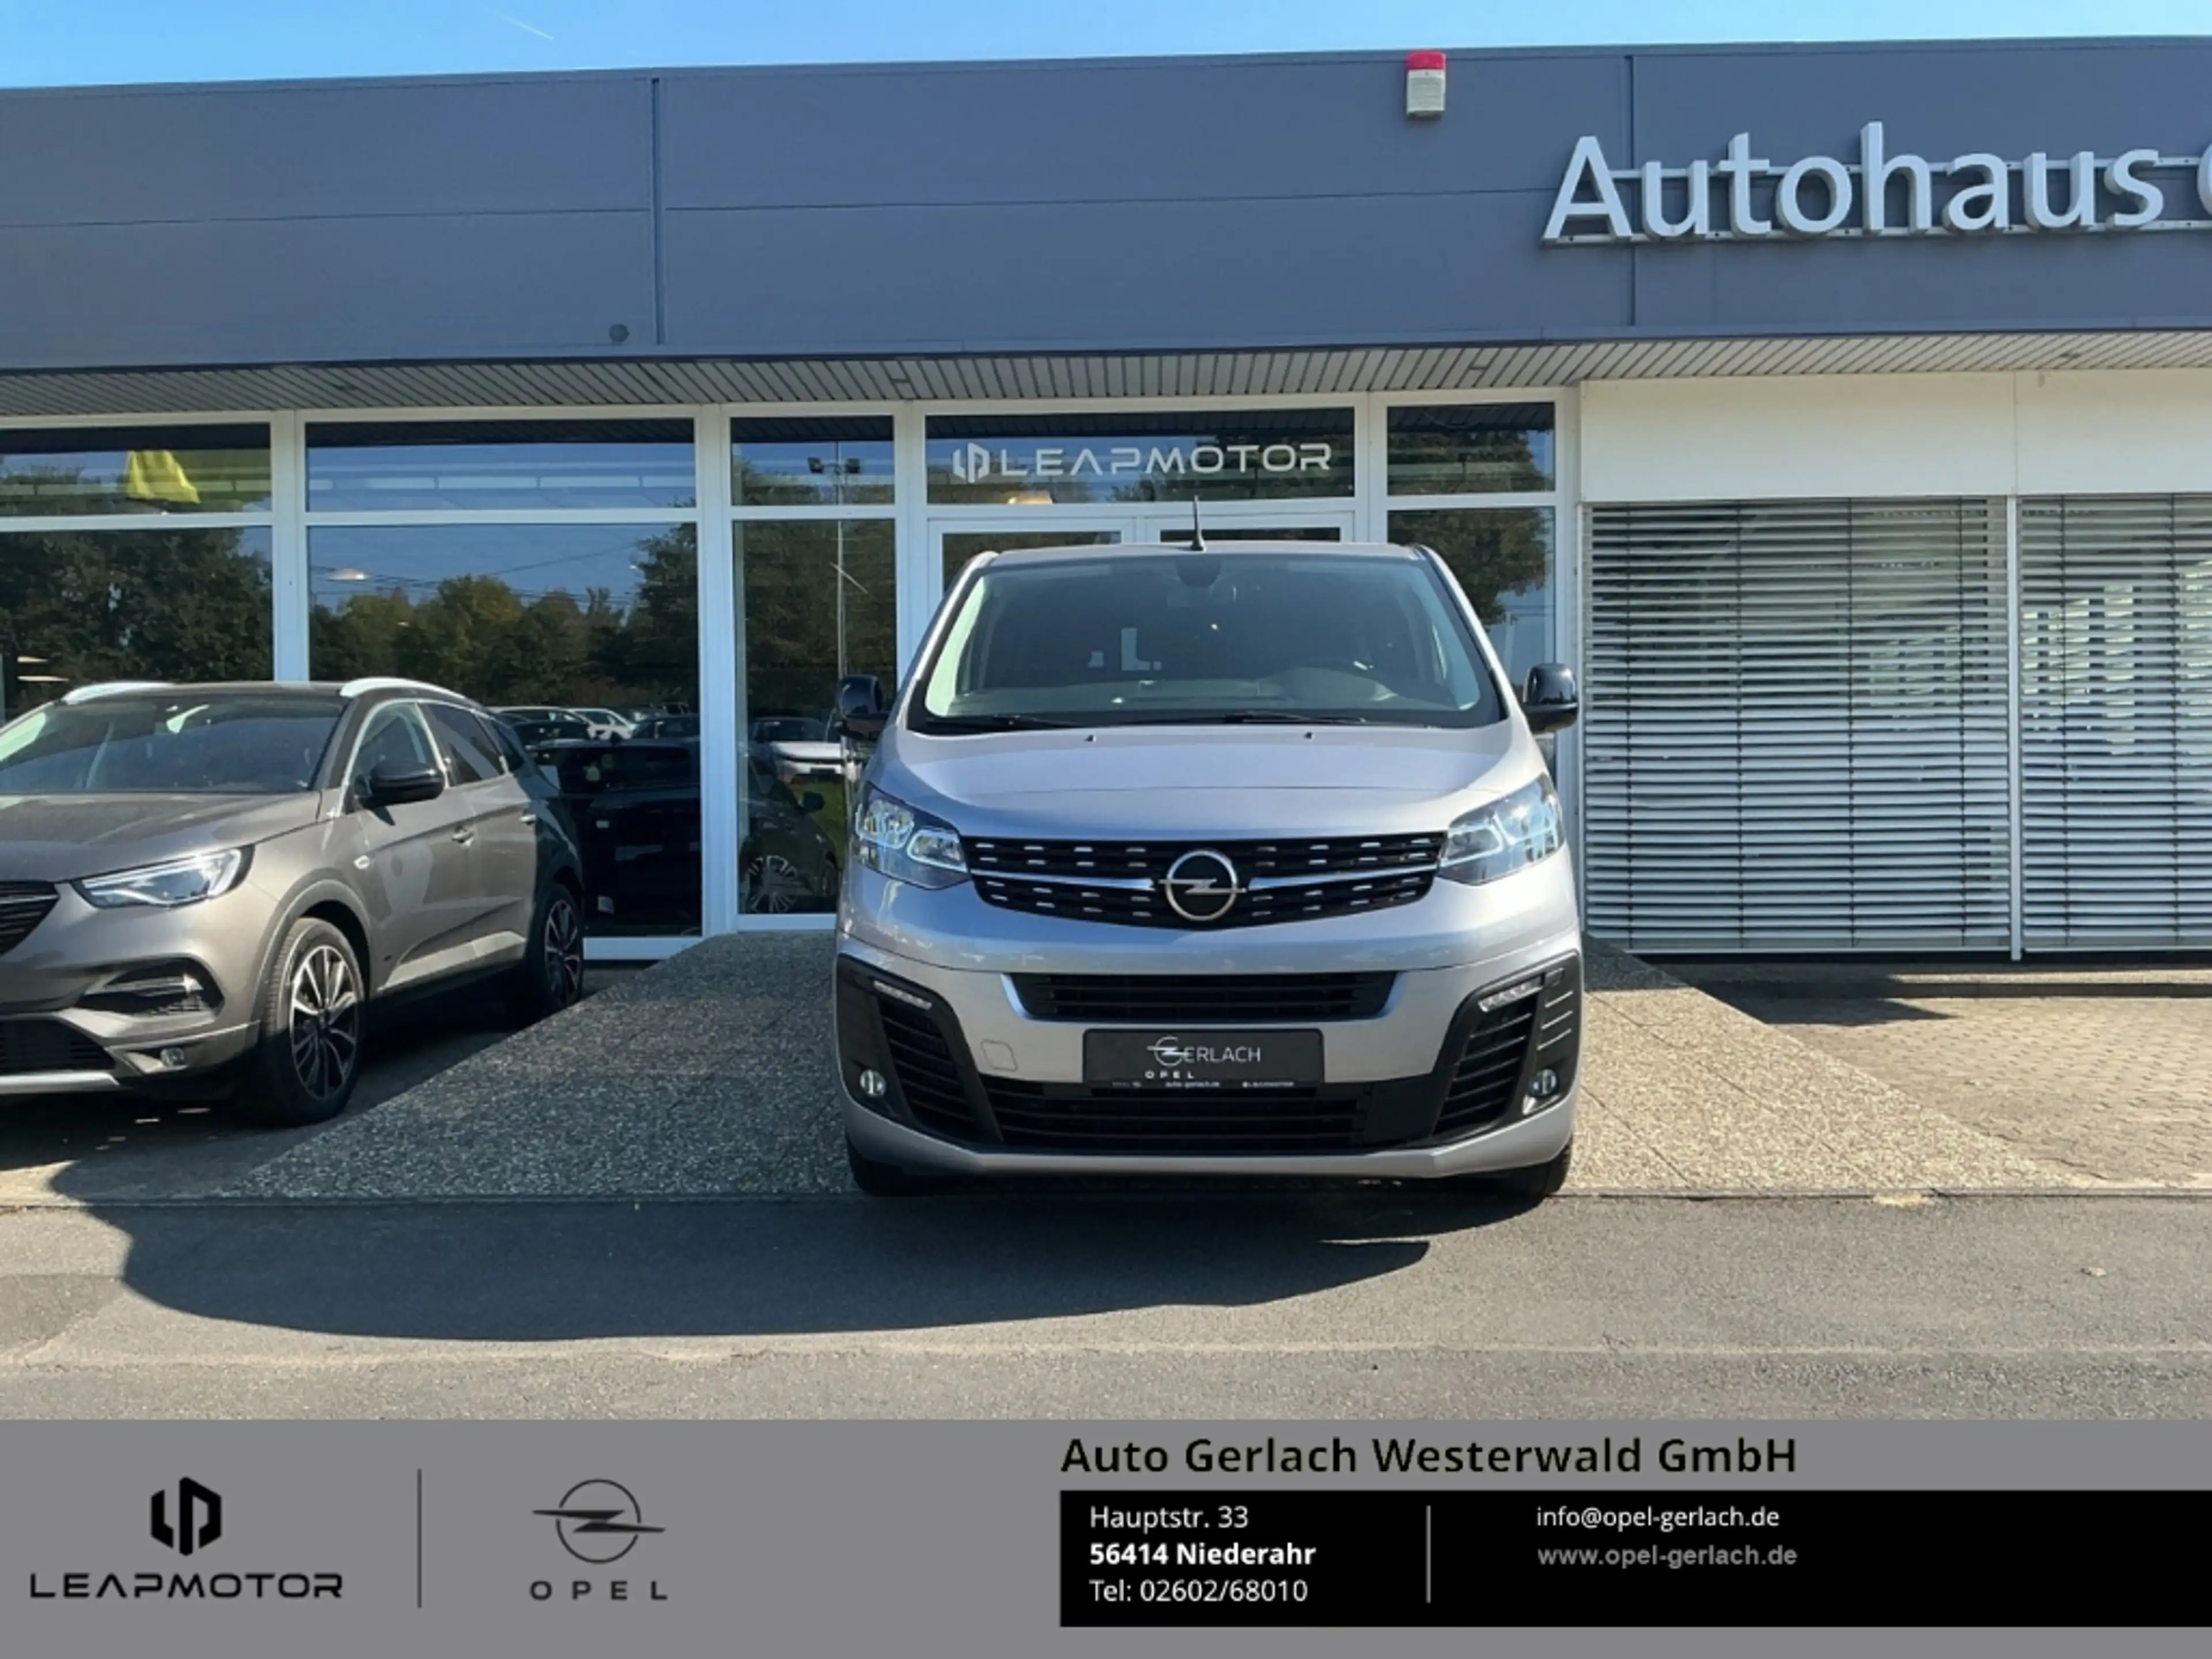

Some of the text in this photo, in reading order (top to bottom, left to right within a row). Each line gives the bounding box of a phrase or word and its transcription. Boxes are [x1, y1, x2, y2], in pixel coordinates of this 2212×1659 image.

[1543, 122, 2164, 240] Autohaus
[1001, 444, 1331, 476] LEAPMOTOR
[1145, 1070, 1195, 1080] OPEL
